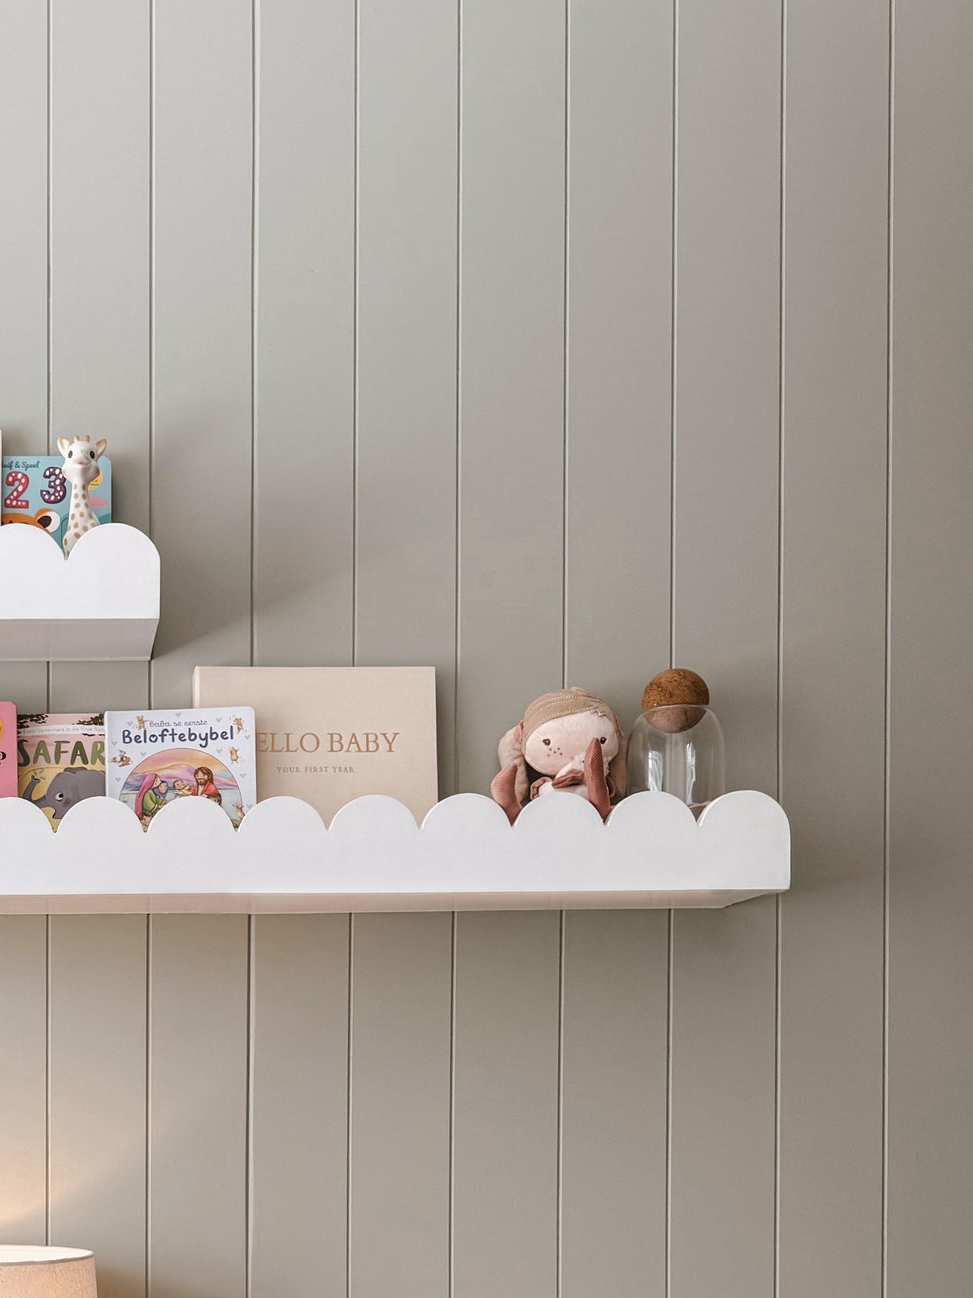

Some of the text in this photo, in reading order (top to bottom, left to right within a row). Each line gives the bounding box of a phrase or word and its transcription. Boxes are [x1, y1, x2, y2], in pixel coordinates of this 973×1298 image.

[3, 466, 67, 509] 2 3
[122, 725, 234, 748] Beloftebybel
[256, 732, 400, 753] ELLO BABY
[18, 739, 105, 768] SAFAR
